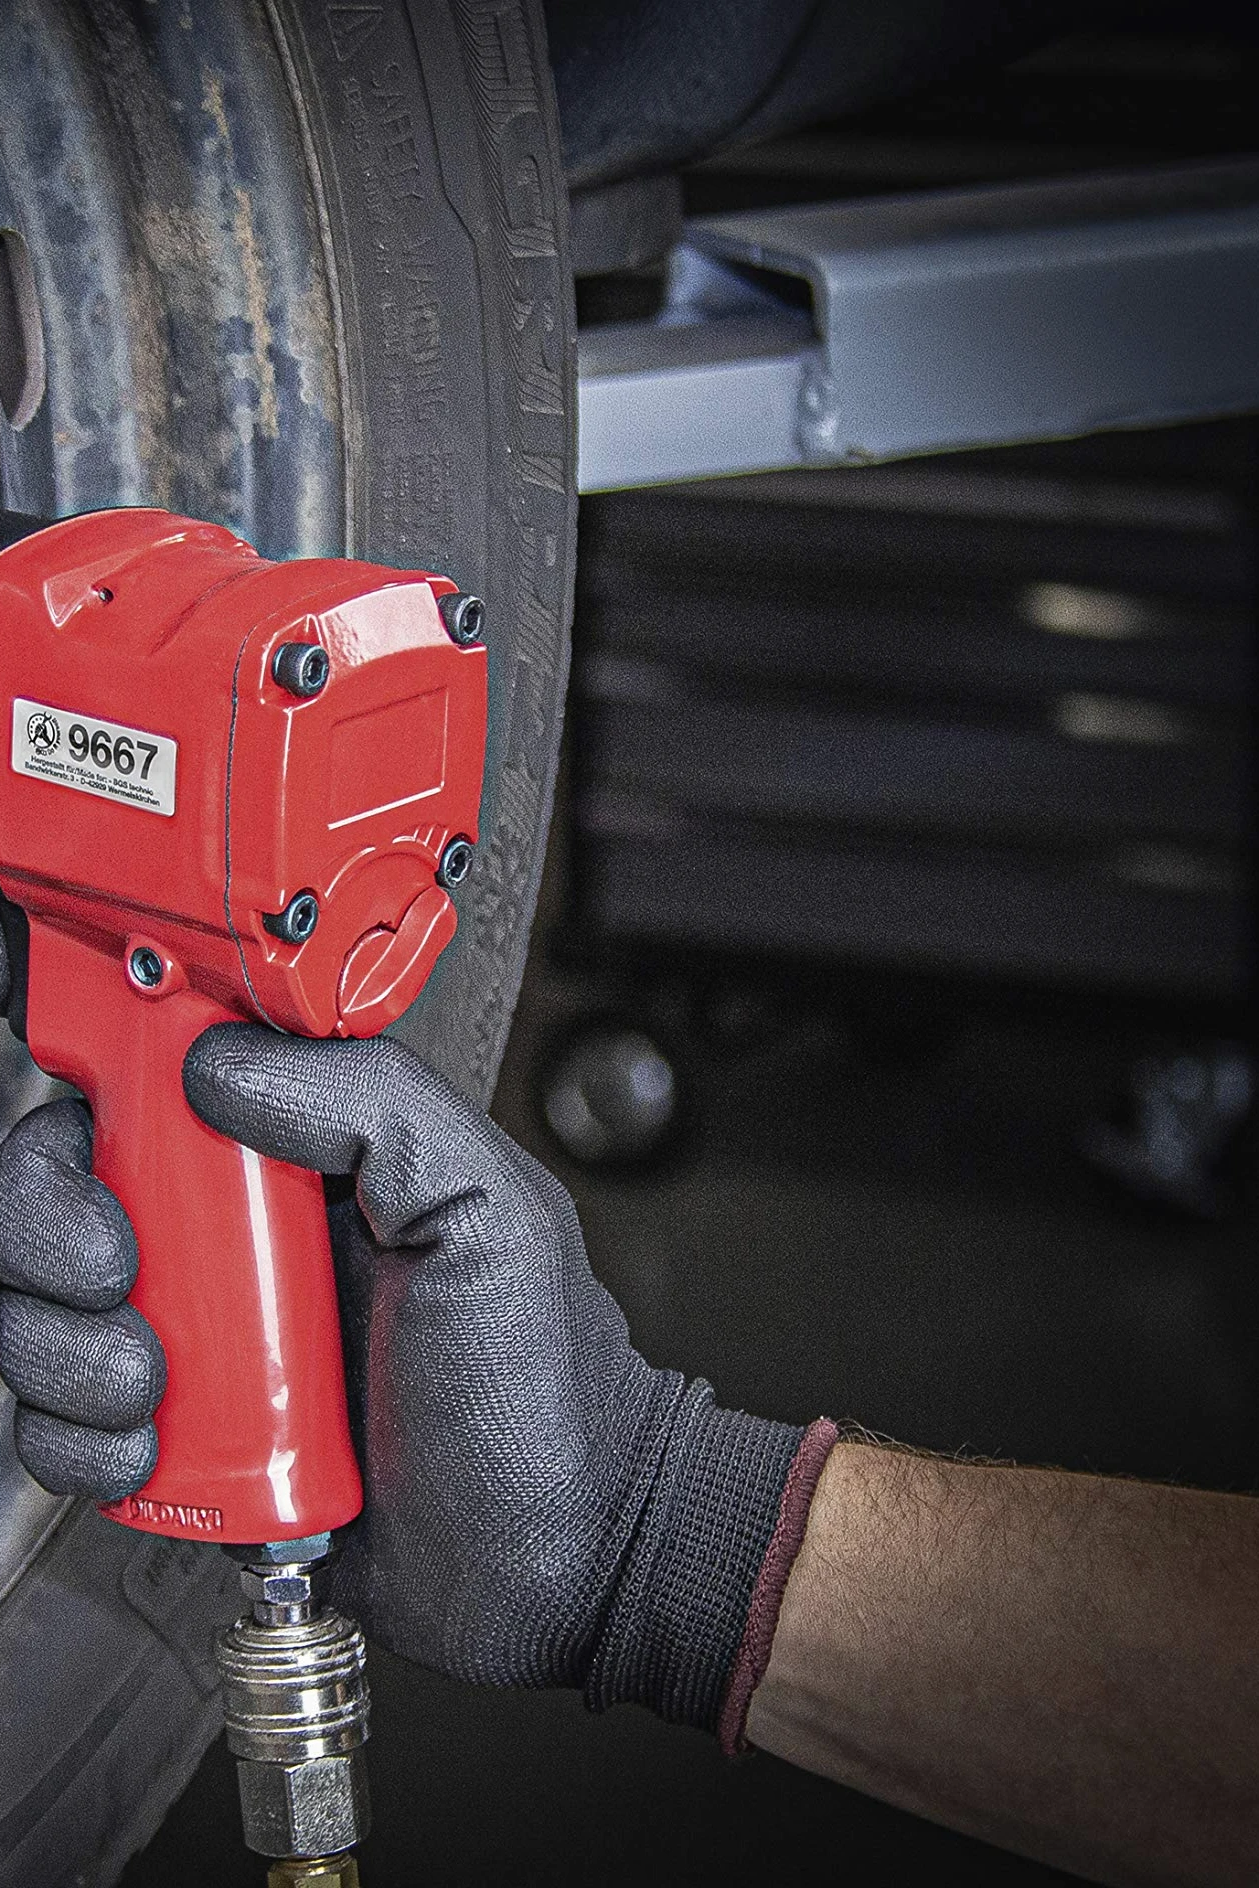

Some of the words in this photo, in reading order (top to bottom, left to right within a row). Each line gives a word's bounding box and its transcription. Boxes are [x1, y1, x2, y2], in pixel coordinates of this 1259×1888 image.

[370, 61, 426, 203] SAFETY
[68, 724, 158, 779] 9667
[107, 784, 161, 807] Wermelskirchen
[113, 778, 128, 789] BGS
[129, 783, 153, 796] technic
